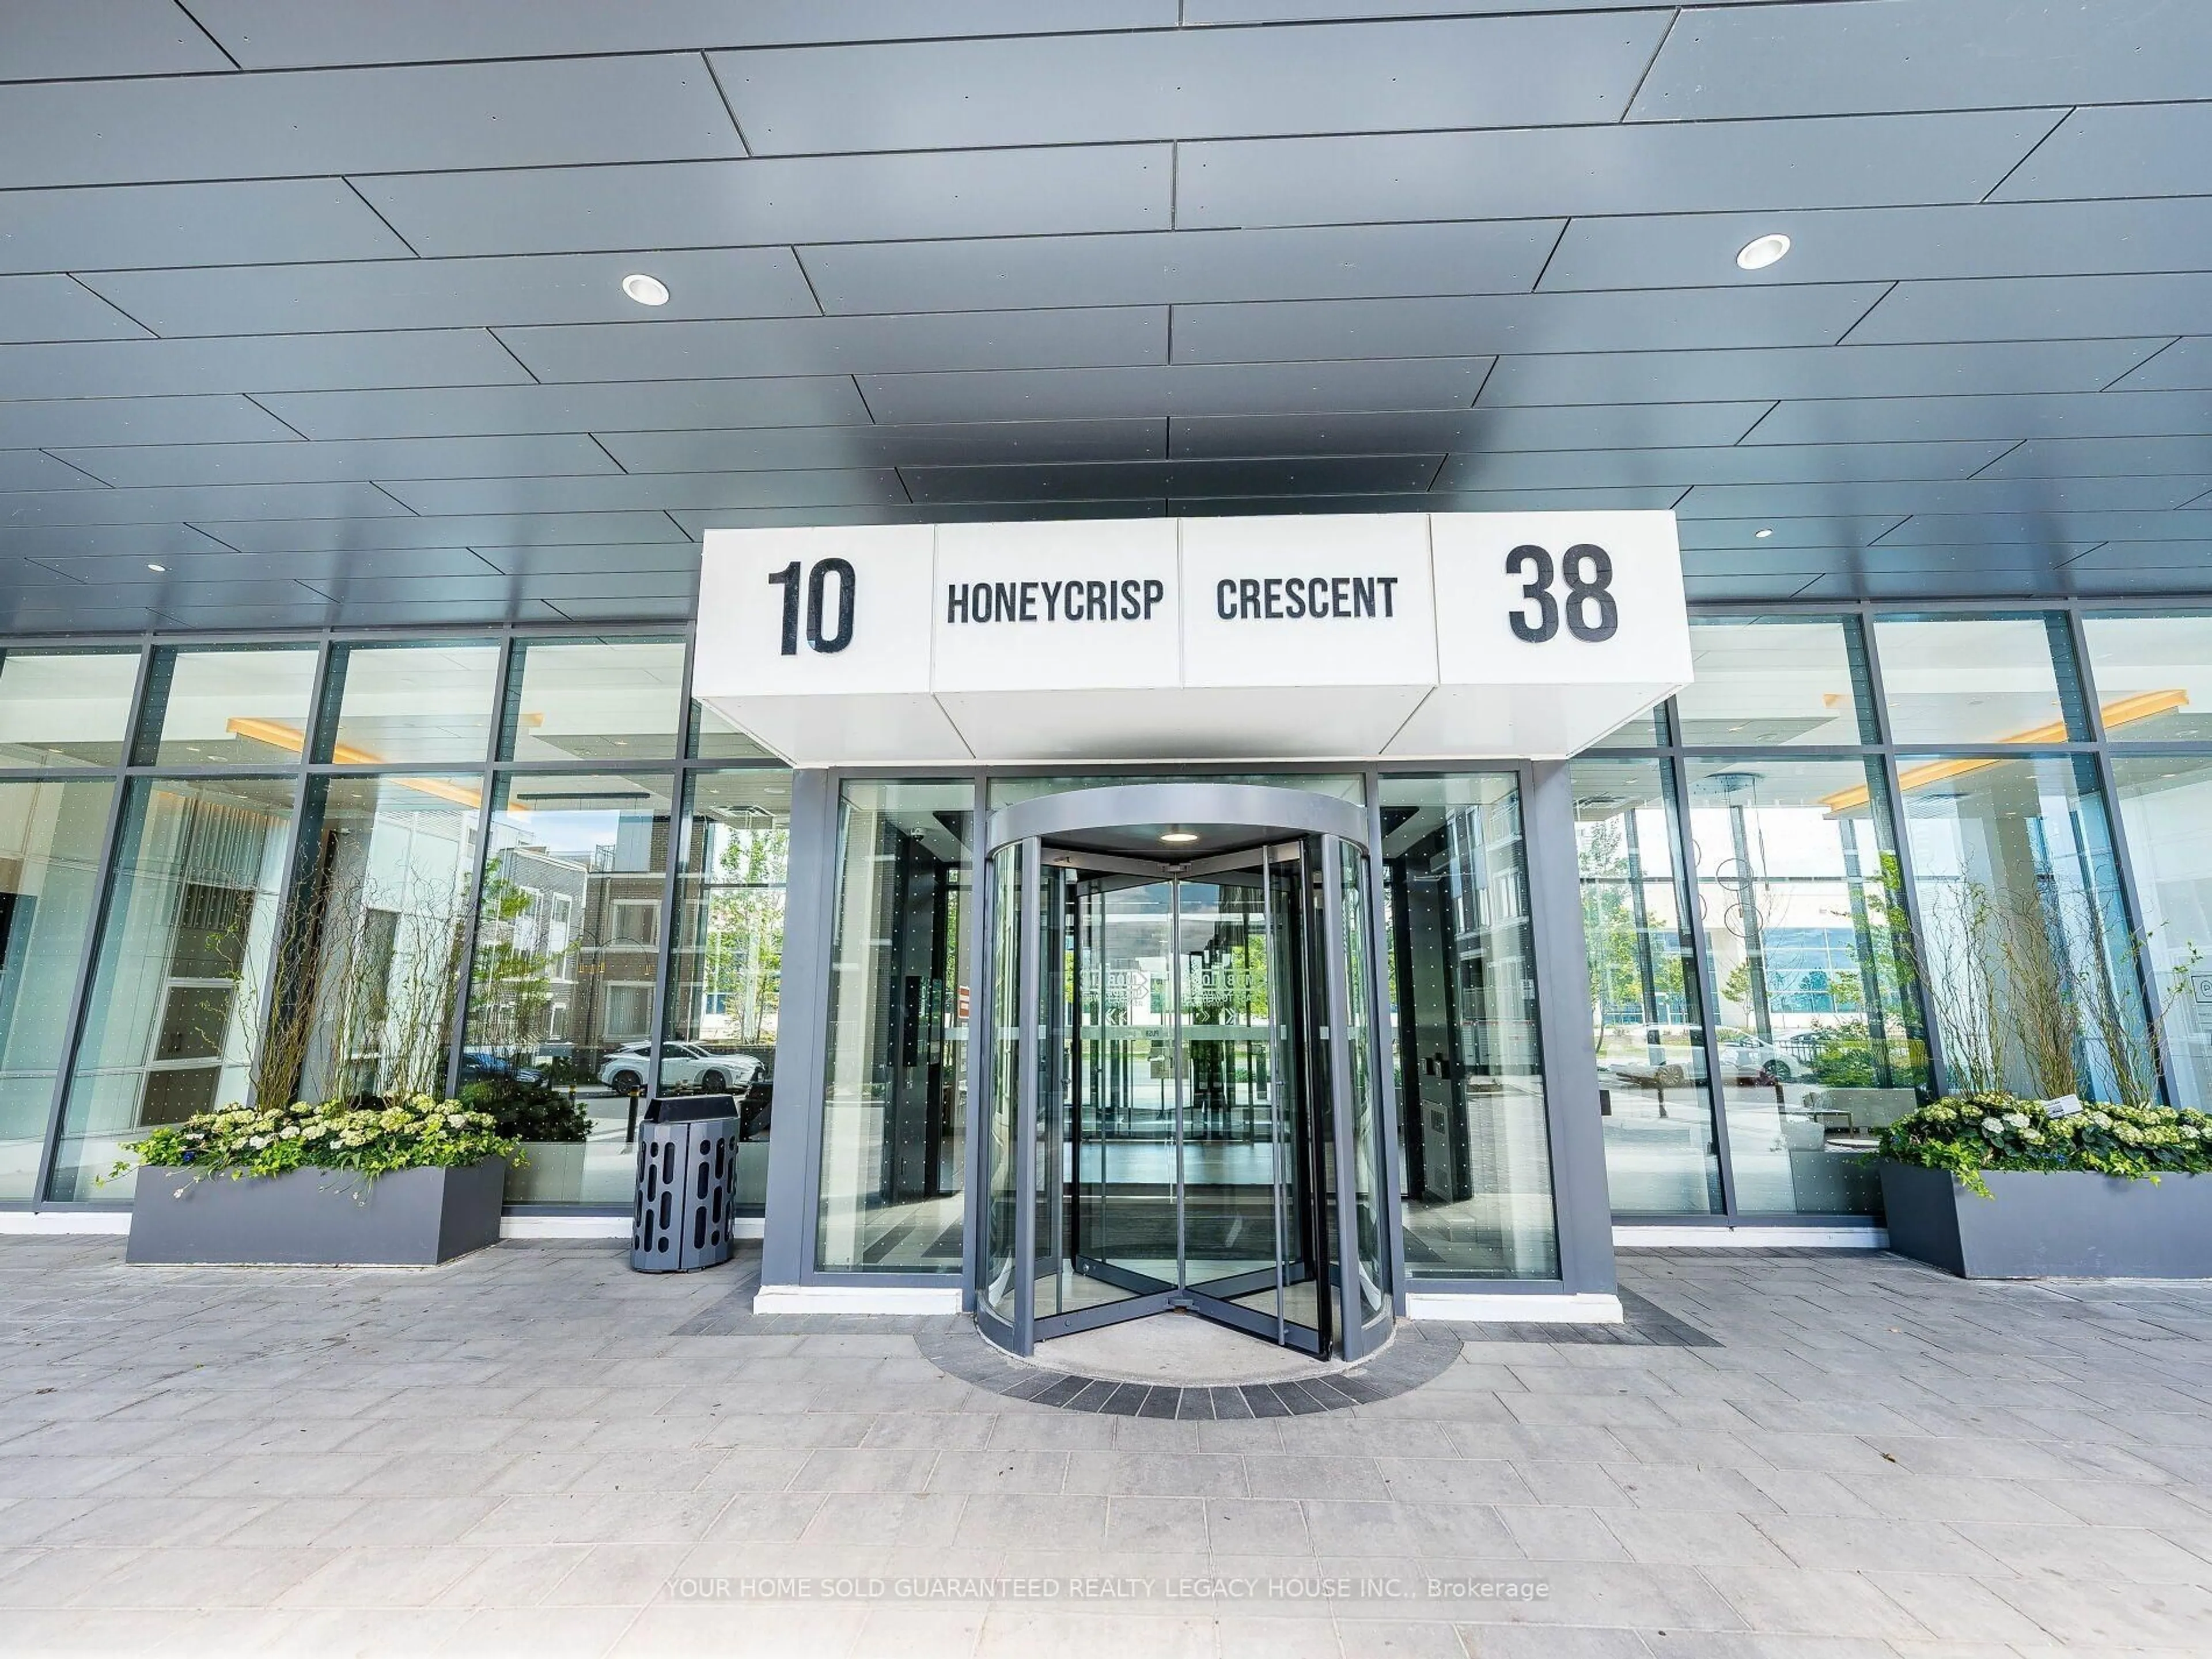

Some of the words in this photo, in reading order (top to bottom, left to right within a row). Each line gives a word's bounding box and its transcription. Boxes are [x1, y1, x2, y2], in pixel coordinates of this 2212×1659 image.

[769, 558, 855, 655] 10
[948, 580, 1163, 623] HONEYCRISP
[1218, 578, 1397, 619] CRESCENT
[1506, 544, 1618, 642] 38
